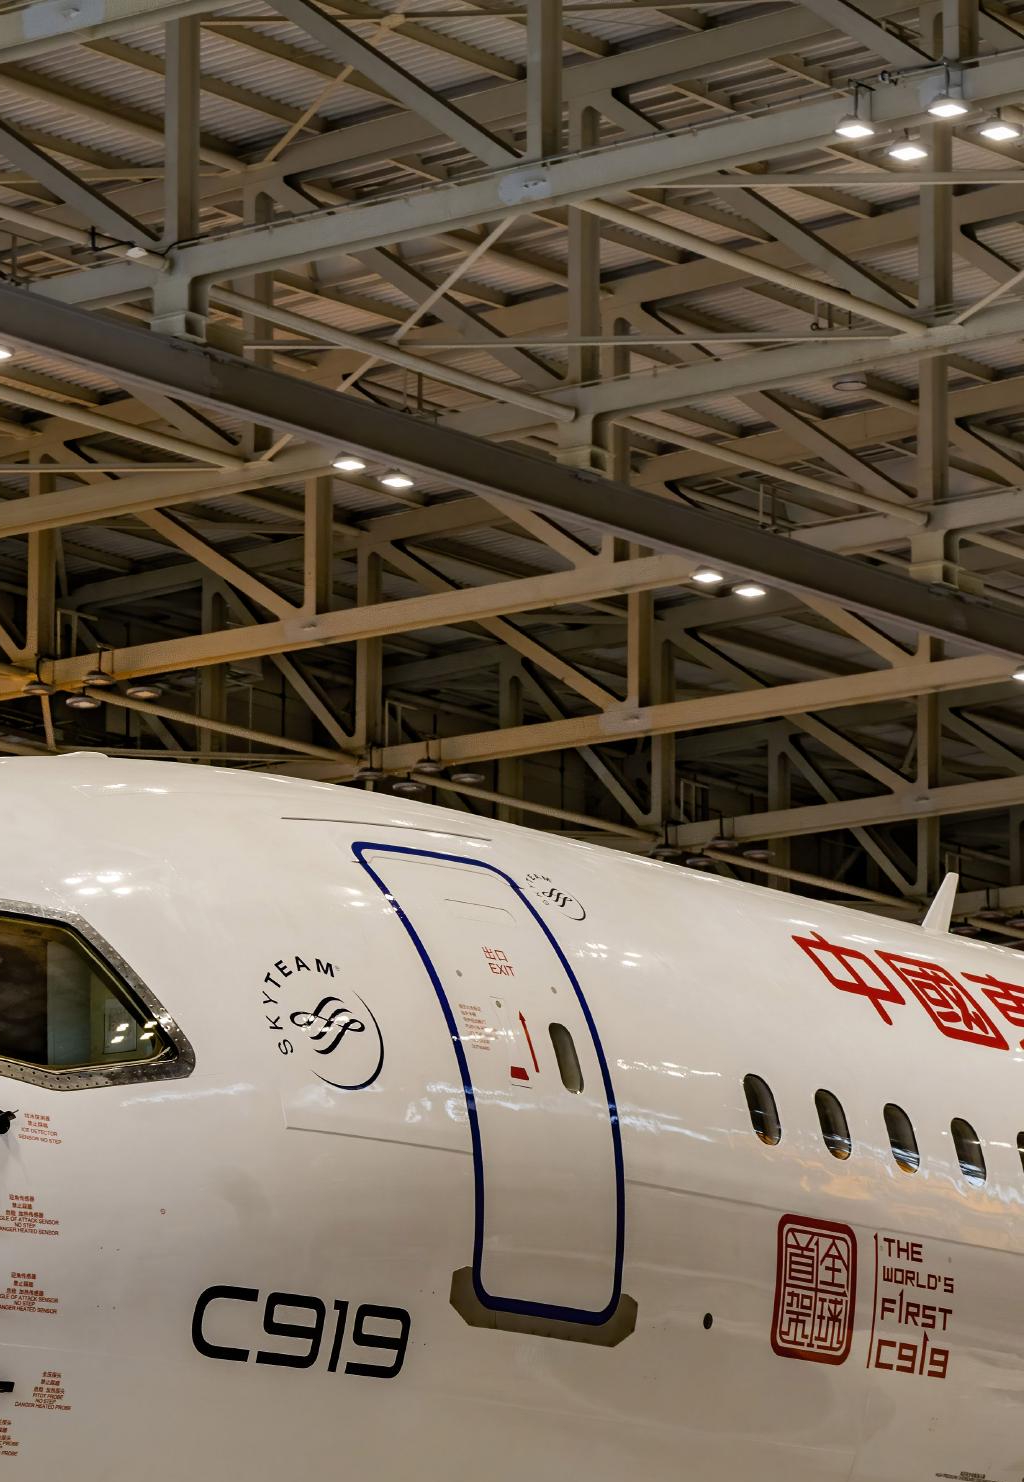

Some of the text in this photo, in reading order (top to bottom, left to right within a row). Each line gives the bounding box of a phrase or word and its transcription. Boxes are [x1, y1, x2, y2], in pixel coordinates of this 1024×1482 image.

[482, 946, 508, 962] 出口
[488, 962, 515, 976] EXIT
[262, 956, 334, 1055] SKYTEAM
[884, 1238, 923, 1262] THE
[882, 1266, 954, 1294] WORLD'S
[880, 1289, 952, 1330] FIRST
[192, 1285, 410, 1378] C919
[874, 1331, 949, 1378] C919
